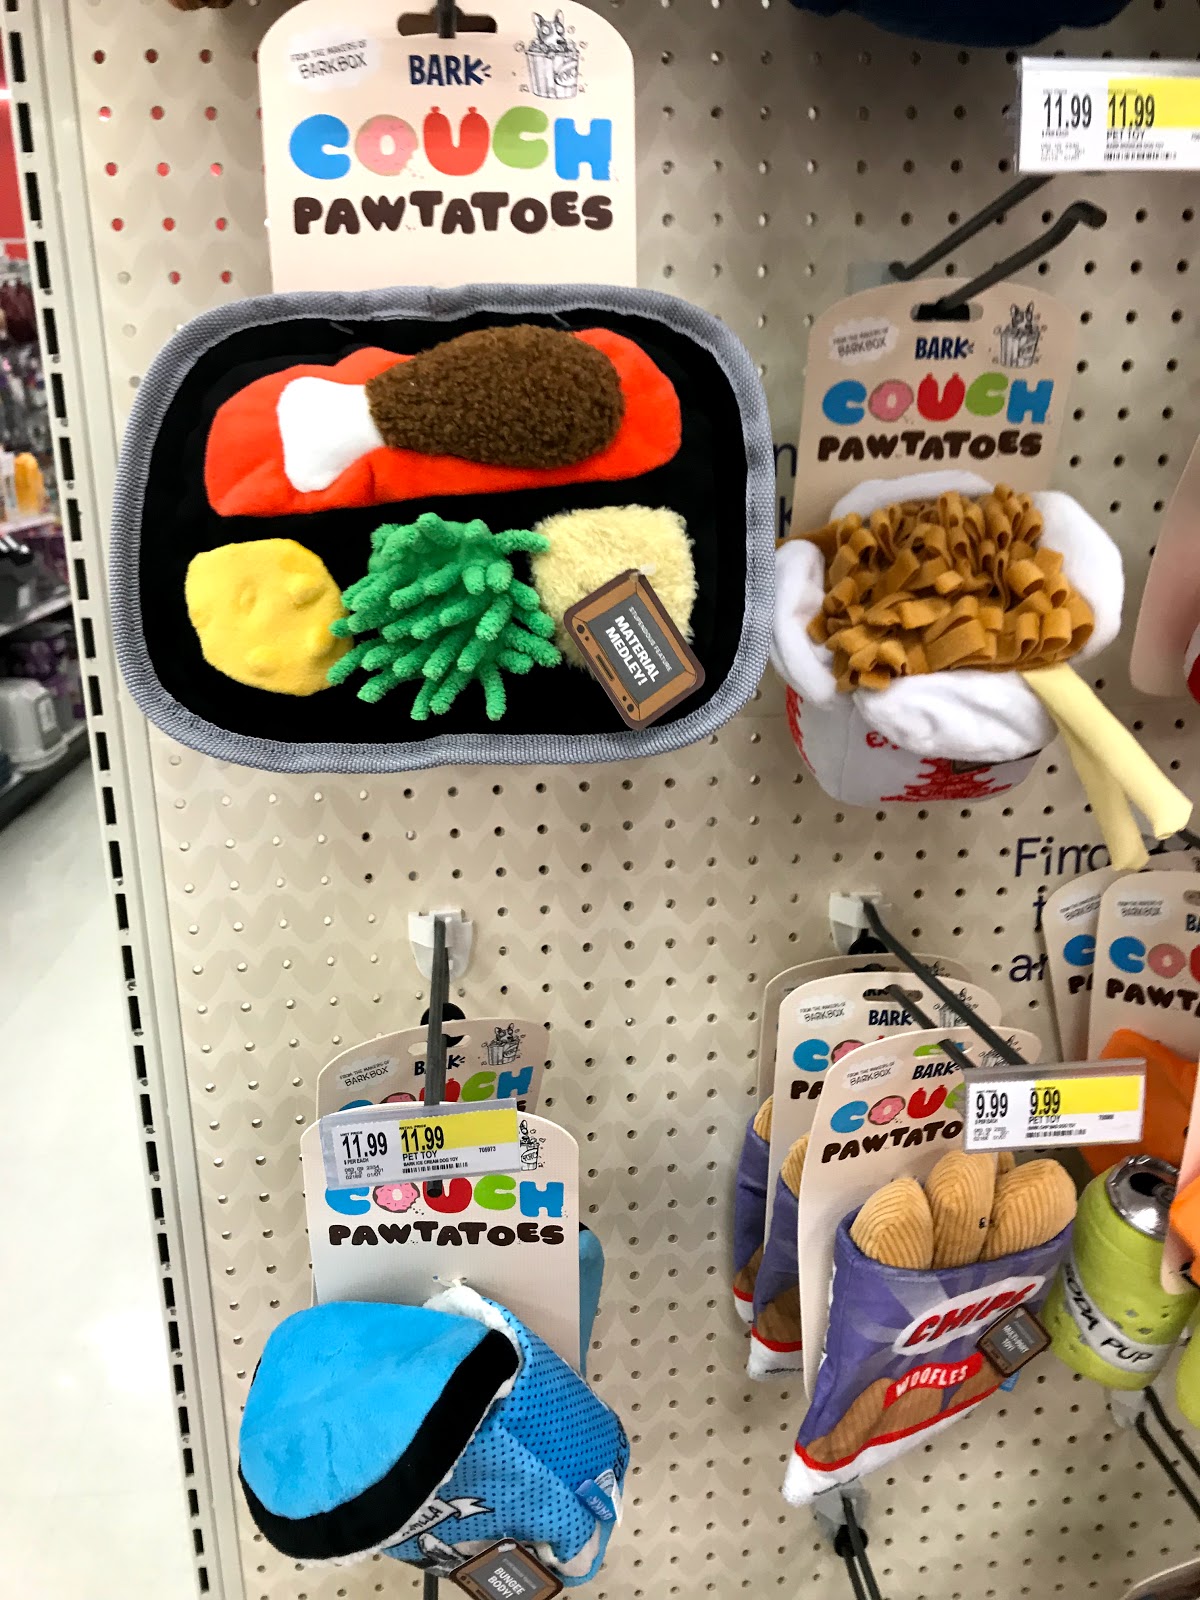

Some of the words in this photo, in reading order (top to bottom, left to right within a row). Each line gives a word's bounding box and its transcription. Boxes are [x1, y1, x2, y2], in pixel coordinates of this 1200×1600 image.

[409, 54, 486, 86] BARK
[1043, 93, 1092, 129] 11.99
[1108, 94, 1155, 129] 11.99
[289, 106, 612, 181] COUCH
[293, 190, 614, 234] PAWTATOES
[915, 336, 968, 360] BARK
[821, 372, 1055, 425] COUCH
[817, 430, 1043, 462] PAWTATOES
[605, 626, 649, 686] MEDLEY!
[614, 615, 660, 683] MATERIAL
[804, 1008, 846, 1023] BARKBOX
[868, 1010, 913, 1026] BARK
[339, 1072, 353, 1080] FROM
[353, 1068, 363, 1076] THE
[363, 1063, 383, 1073] MAKERS
[414, 1054, 461, 1077] BK
[850, 1067, 892, 1087] BARKBOX
[911, 1061, 956, 1081] BARK
[830, 1085, 966, 1134] COU
[976, 1092, 1009, 1119] 9.99
[1029, 1089, 1061, 1116] 9.99
[1028, 1116, 1043, 1125] PET
[1044, 1115, 1061, 1124] TOY
[342, 1131, 388, 1159] 11.99
[401, 1125, 445, 1153] 11.99
[821, 1120, 964, 1164] PAWTATO
[402, 1152, 419, 1162] PET
[420, 1150, 438, 1160] TOY
[325, 1174, 564, 1218] COUCH
[328, 1221, 565, 1247] PAWTATOES
[1100, 1337, 1154, 1363] PUP
[895, 1365, 969, 1398] WOOFLES
[487, 1575, 514, 1599] BODY!
[494, 1566, 526, 1596] BUNGEE
